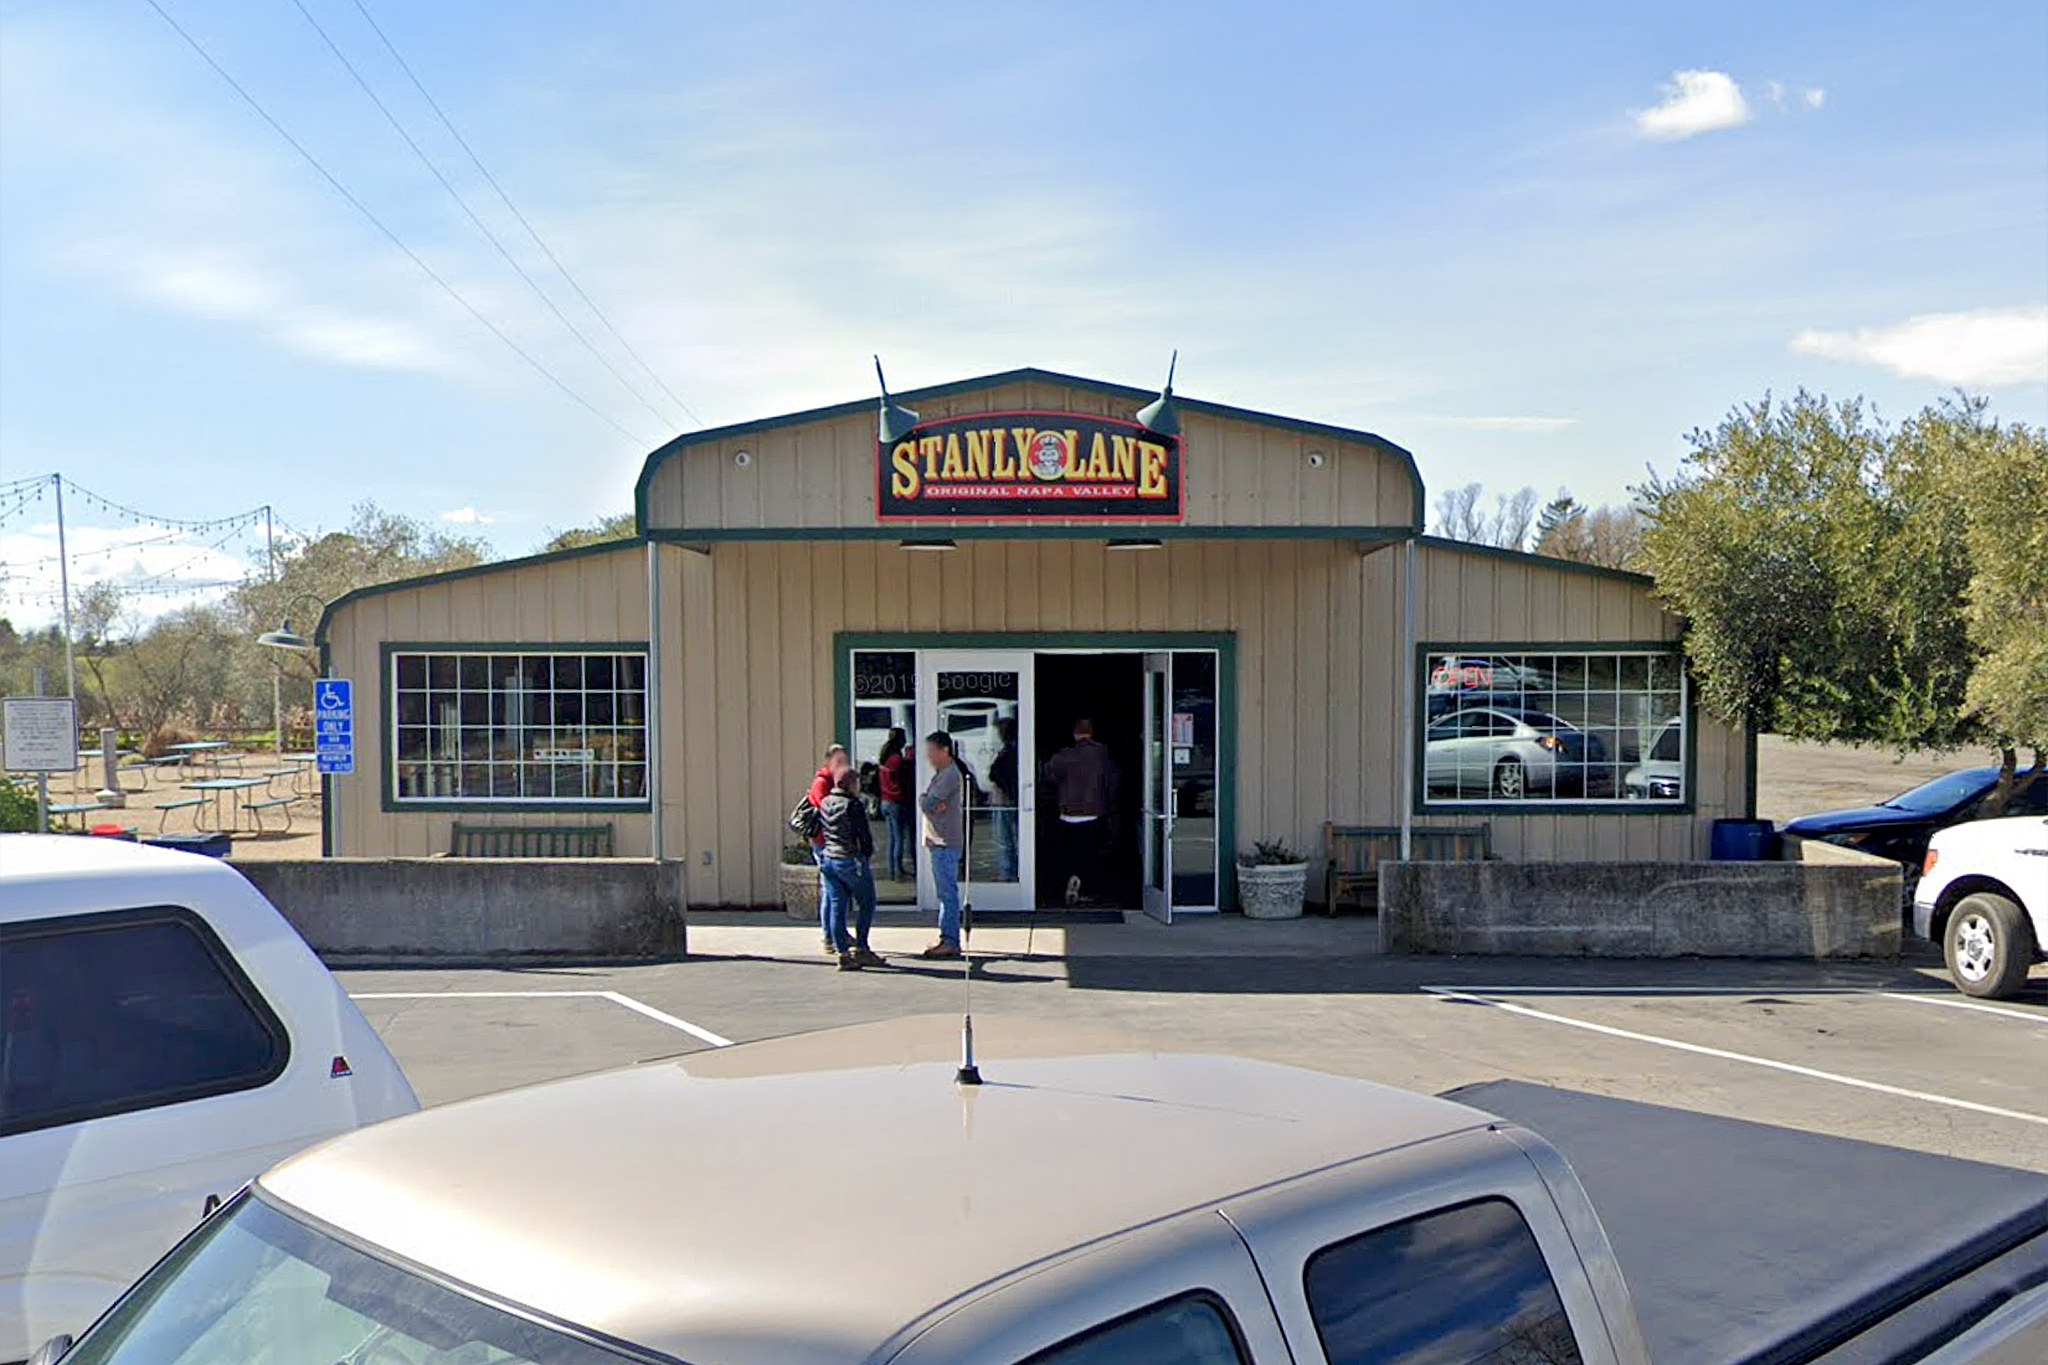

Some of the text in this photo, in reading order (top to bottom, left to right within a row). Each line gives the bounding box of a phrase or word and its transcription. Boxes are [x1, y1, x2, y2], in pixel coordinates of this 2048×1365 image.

[891, 427, 1168, 499] STANLY LANE
[926, 487, 1134, 496] ORIGINAL NAPA VALLEY
[1431, 666, 1493, 688] OPEN
